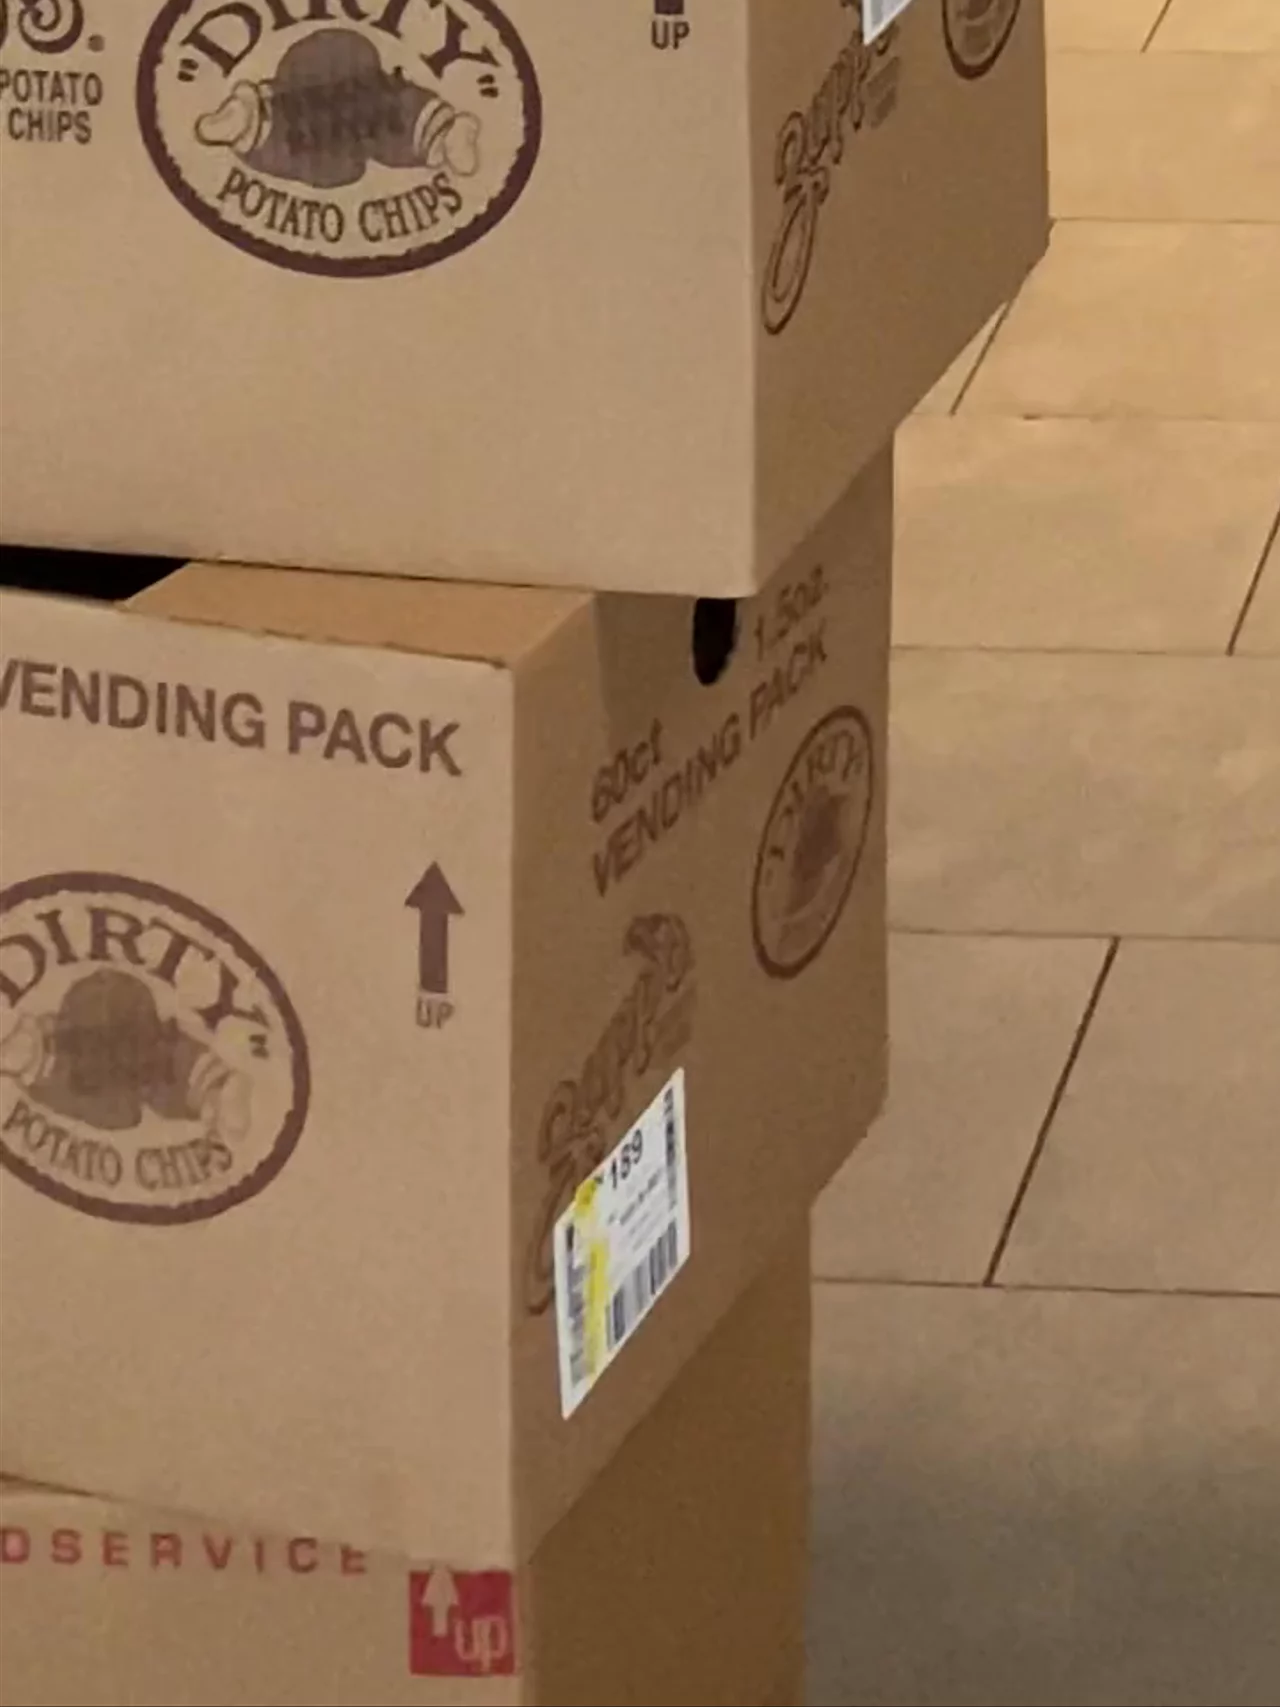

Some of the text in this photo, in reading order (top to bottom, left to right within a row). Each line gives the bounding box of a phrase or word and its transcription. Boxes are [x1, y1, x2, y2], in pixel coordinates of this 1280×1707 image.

[651, 21, 691, 52] UP
[0, 68, 104, 106] POTATO
[8, 107, 92, 145] CHIPS
[216, 166, 464, 244] POTATO CHIPS
[287, 700, 463, 777] PACK
[592, 618, 829, 897] VENDING PACK
[415, 1001, 455, 1030] UP
[2, 1099, 234, 1190] POTATO CHIPS
[593, 1127, 643, 1193] 189
[454, 1614, 509, 1673] up
